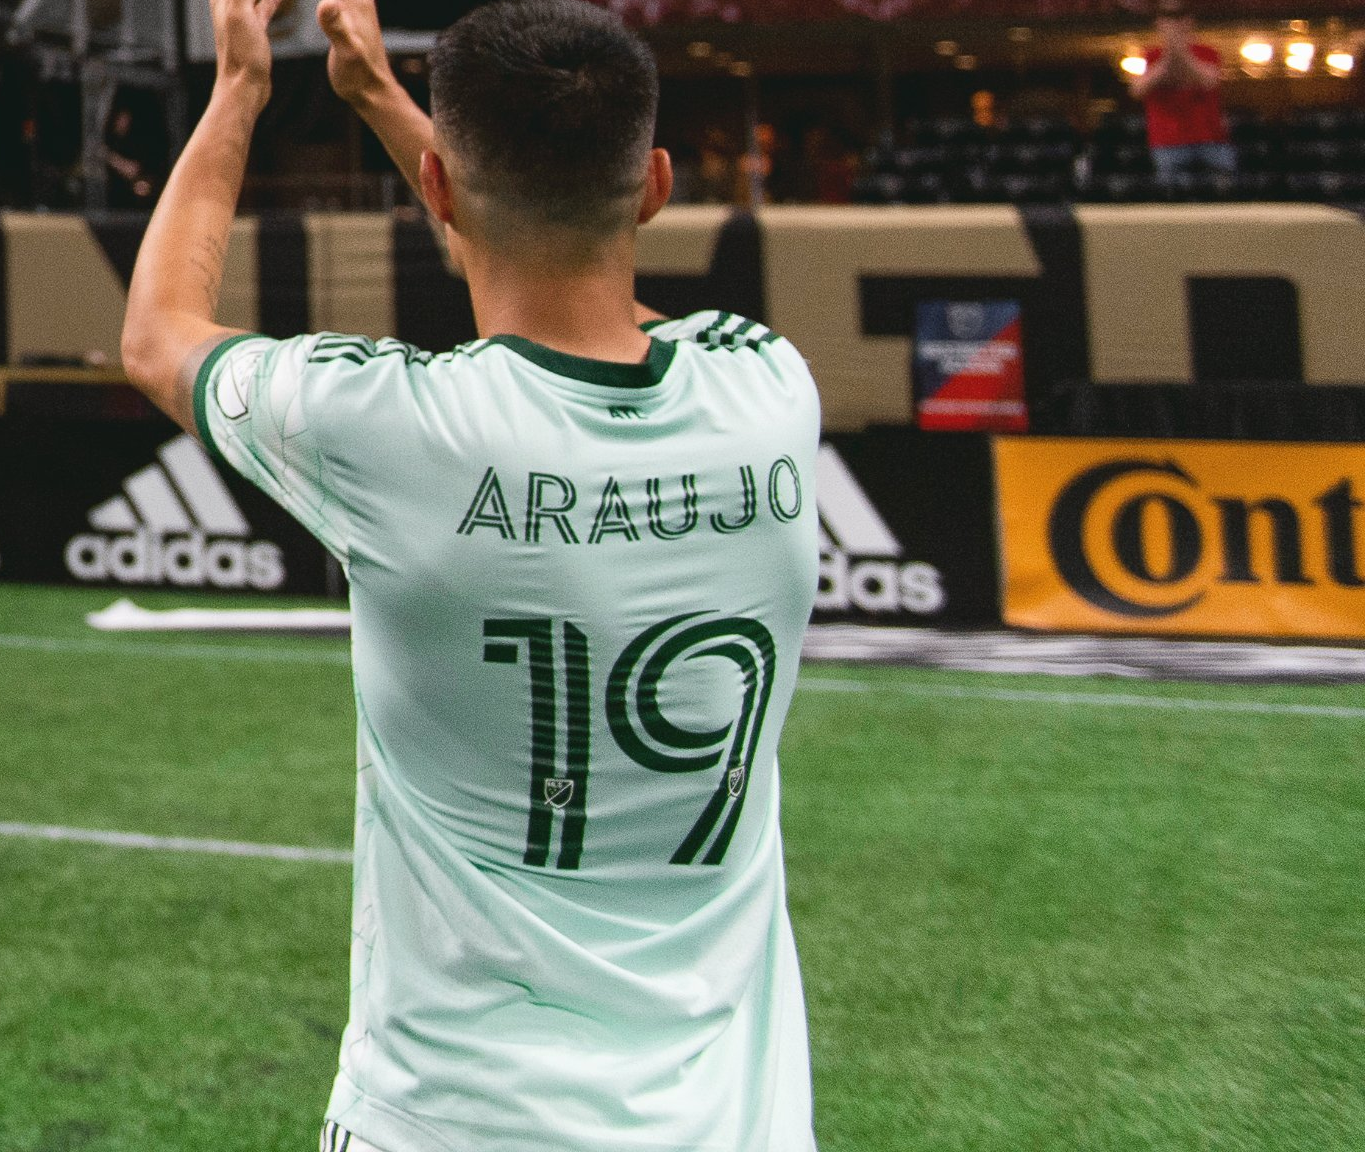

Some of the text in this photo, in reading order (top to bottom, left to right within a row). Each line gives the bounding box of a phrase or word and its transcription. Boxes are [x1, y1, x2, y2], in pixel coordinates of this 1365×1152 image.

[456, 454, 803, 545] ARAUJO
[65, 527, 286, 590] adidas
[482, 608, 777, 870] 19
